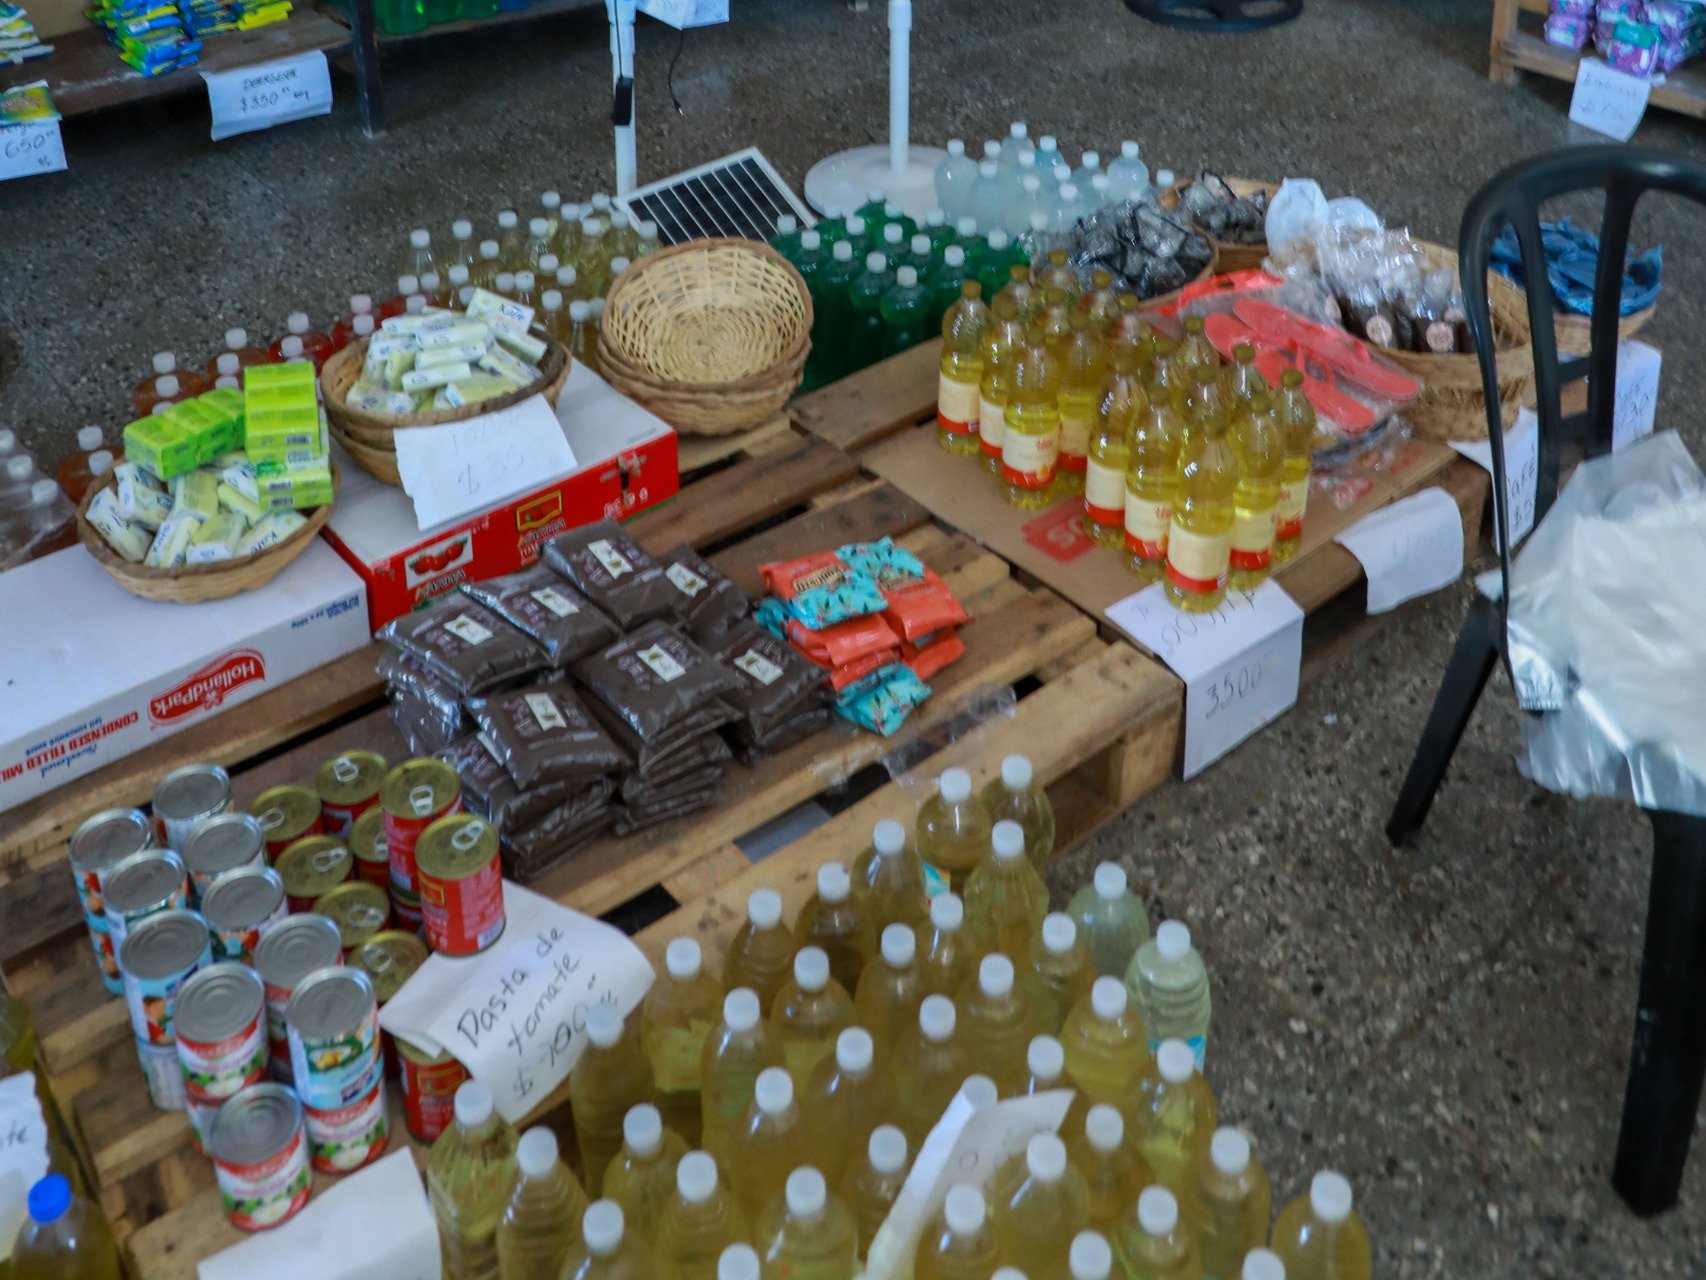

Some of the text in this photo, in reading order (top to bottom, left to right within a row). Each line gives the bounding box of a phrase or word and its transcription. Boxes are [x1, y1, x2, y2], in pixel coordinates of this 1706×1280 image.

[0, 710, 139, 781] CONDENSED FILLED MIL
[457, 926, 565, 1049] Pasta de
[507, 952, 581, 1056] tomate
